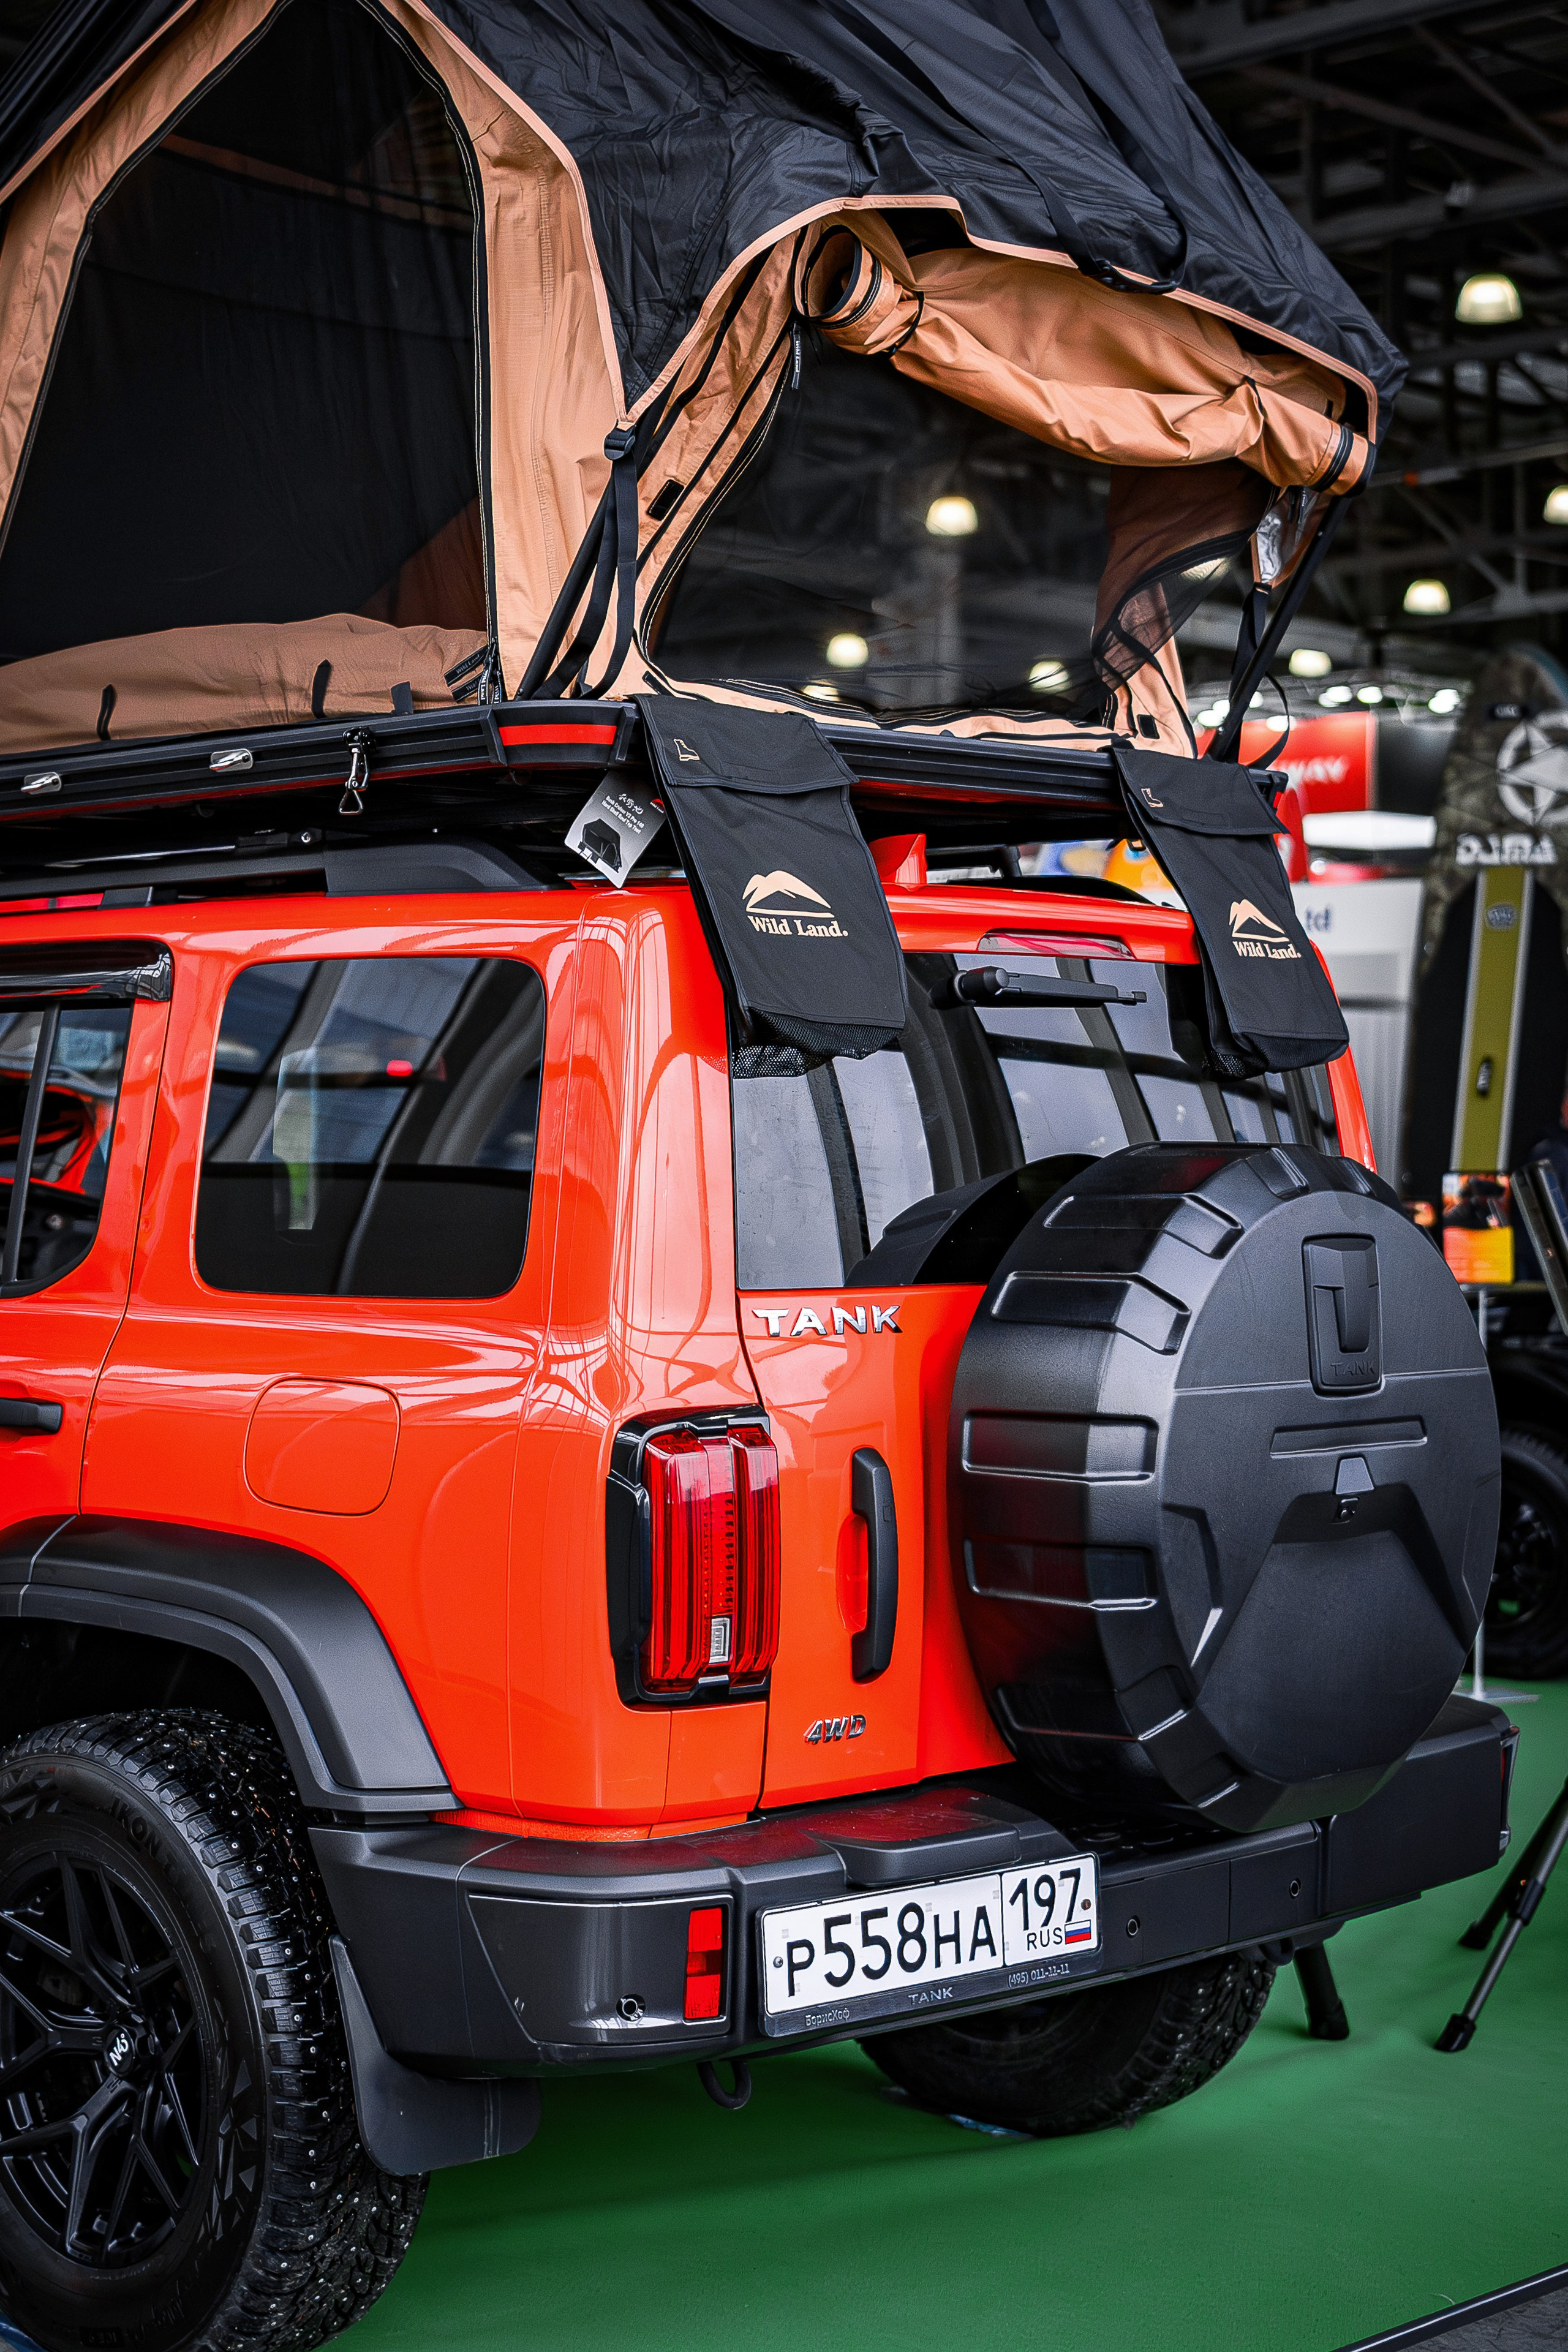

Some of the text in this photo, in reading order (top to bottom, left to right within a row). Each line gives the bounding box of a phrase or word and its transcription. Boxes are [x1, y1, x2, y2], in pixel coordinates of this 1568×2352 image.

[747, 915, 849, 937] Wild Land.
[1232, 941, 1302, 959] Wild Land.
[752, 1305, 903, 1337] TANK
[1330, 1360, 1374, 1377] TANK
[804, 1714, 867, 1745] 4WD
[1009, 1868, 1081, 1931] 197
[1027, 1927, 1063, 1951] RUS
[1008, 1963, 1070, 1988] (495) 011-11-11
[908, 1987, 953, 2005] TANK
[805, 2008, 850, 2027] БорисХоф
